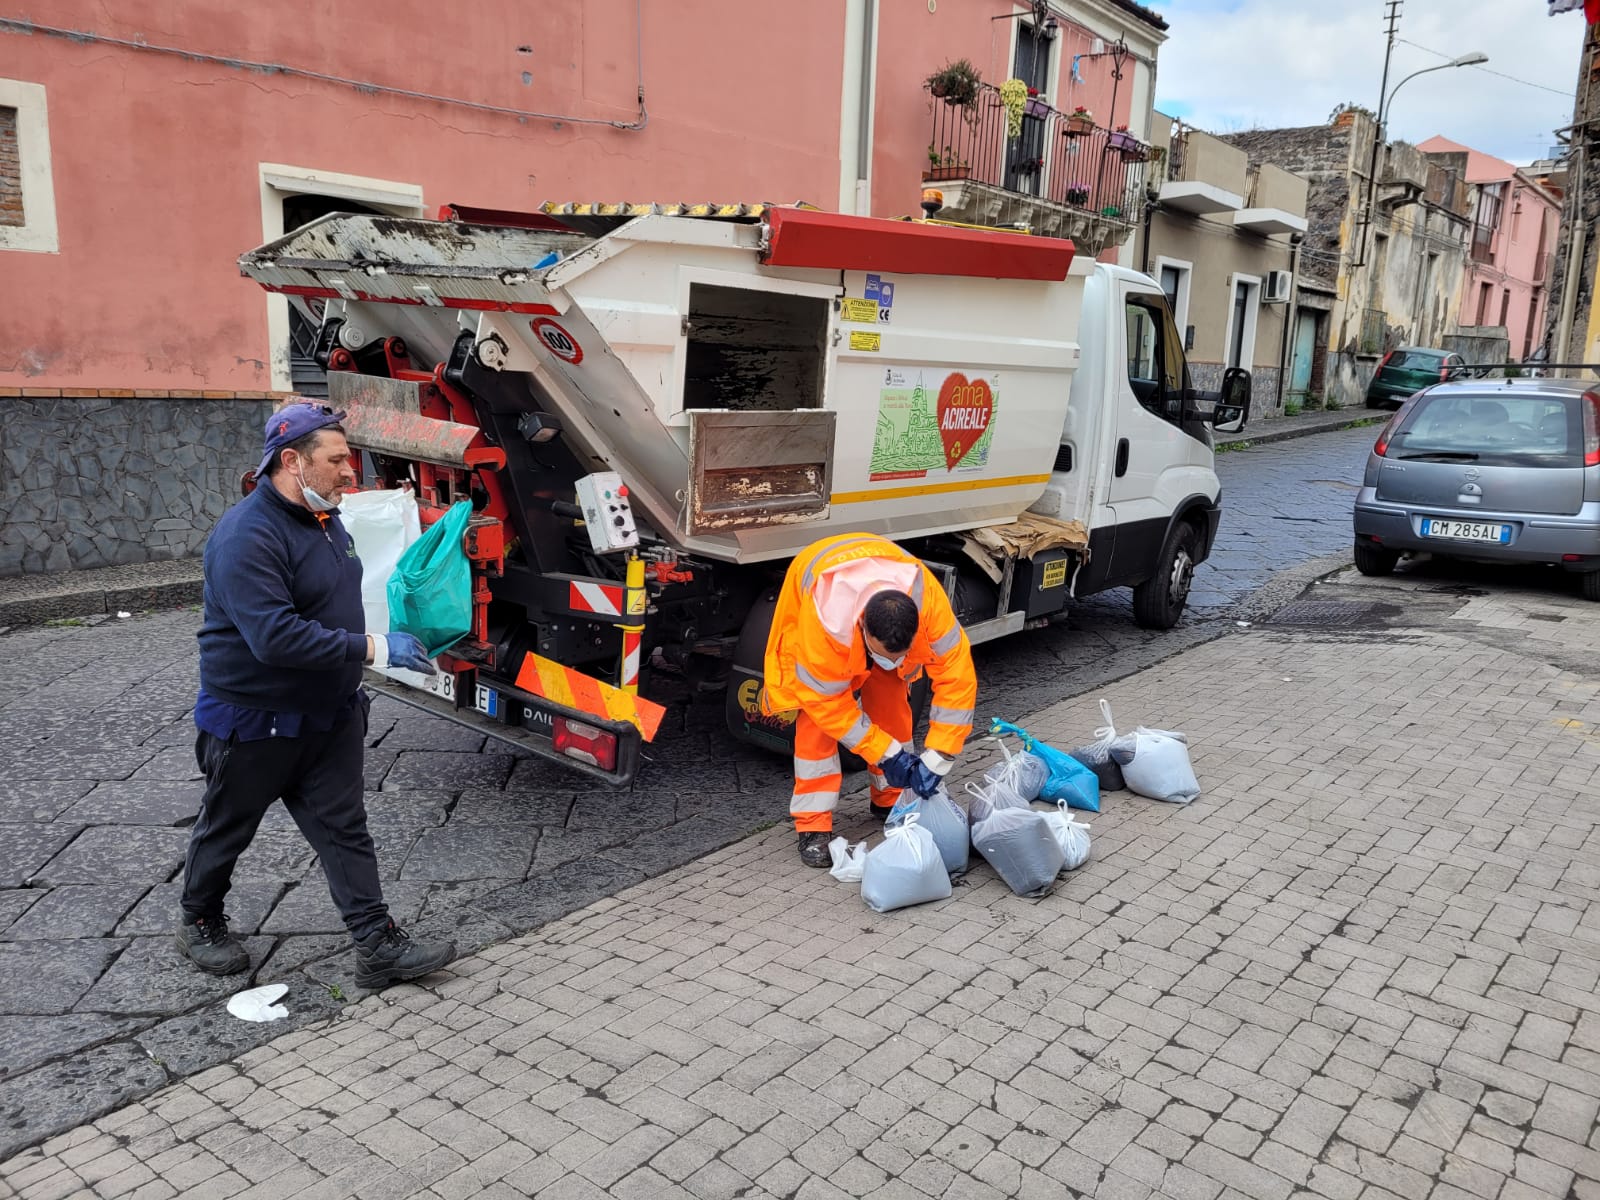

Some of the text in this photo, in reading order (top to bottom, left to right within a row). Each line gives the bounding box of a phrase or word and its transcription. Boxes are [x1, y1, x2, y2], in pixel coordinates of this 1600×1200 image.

[879, 308, 890, 321] CE
[542, 331, 573, 351] 100
[951, 385, 984, 406] ama
[941, 407, 988, 430] ACIREALE
[1431, 521, 1498, 540] CM 285AL
